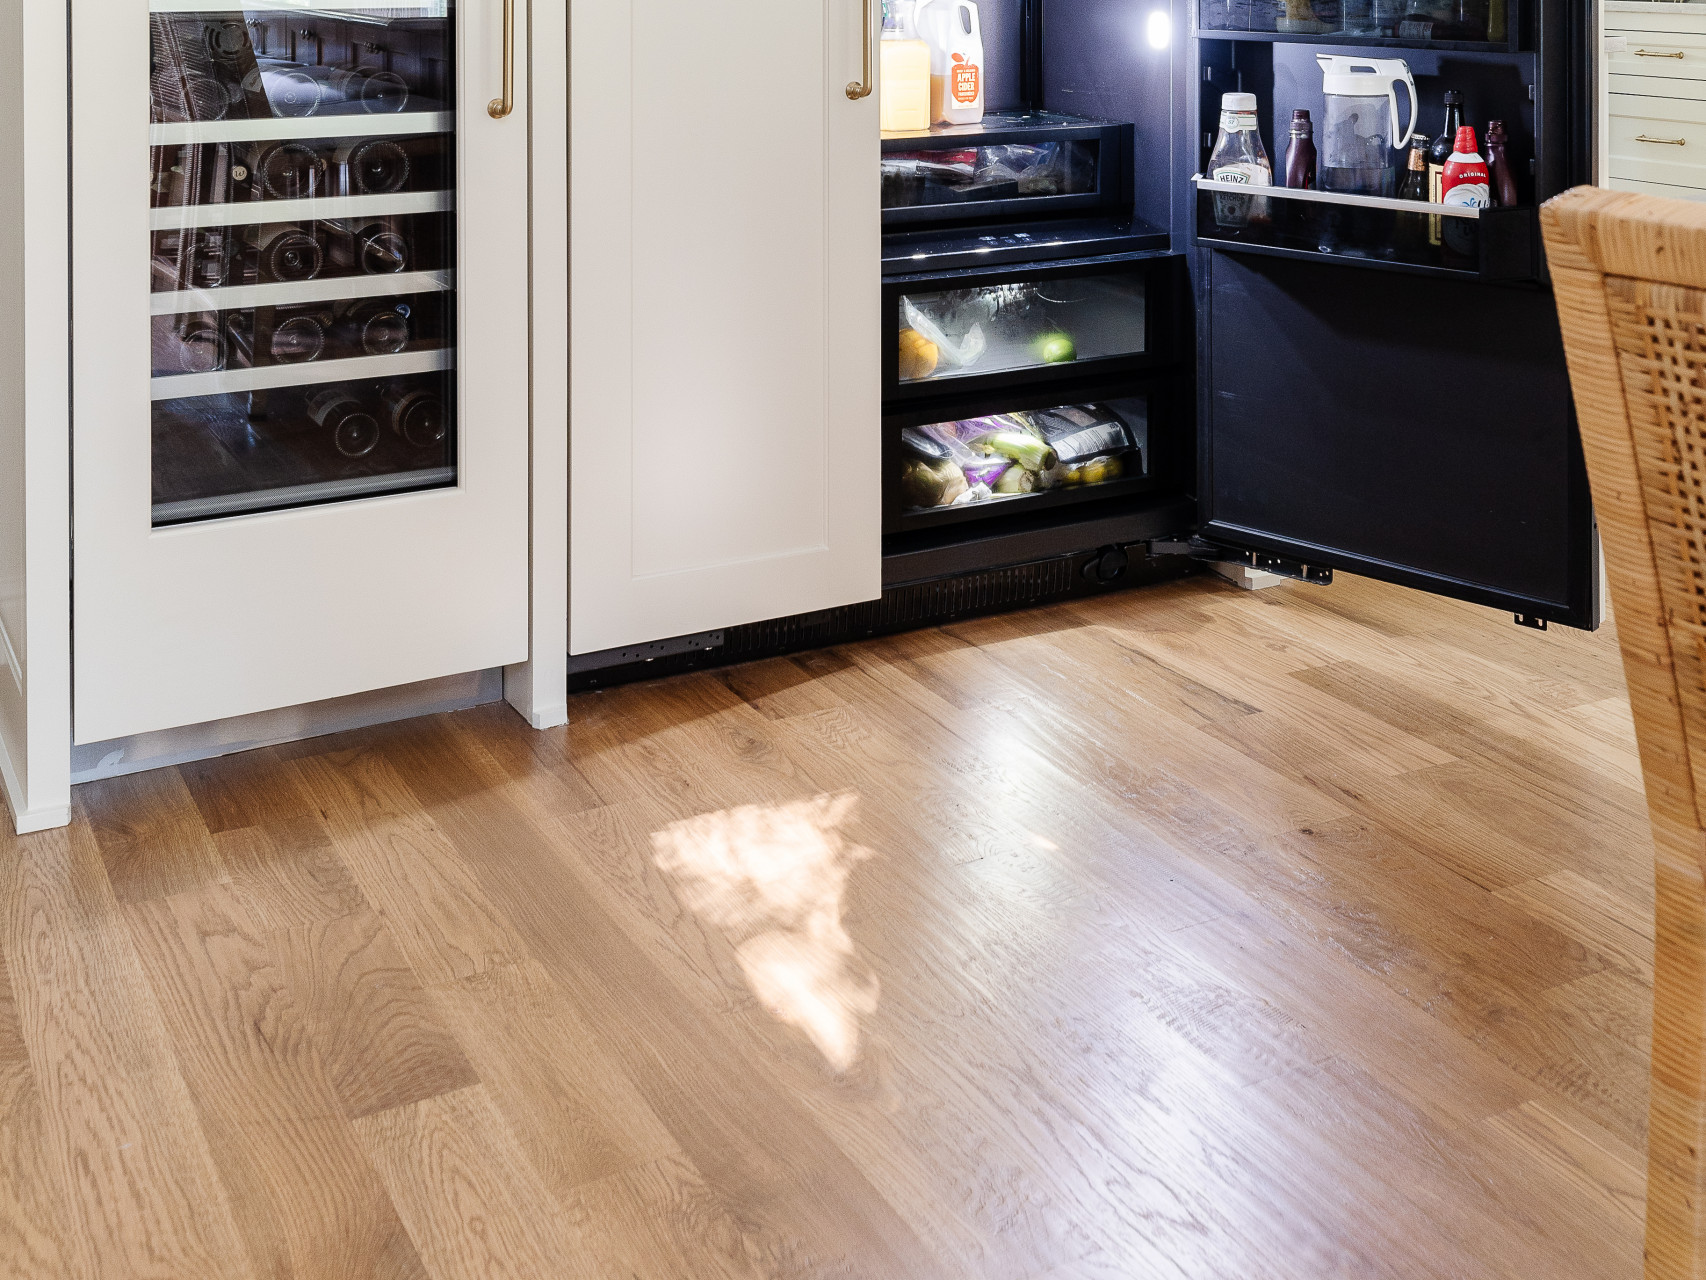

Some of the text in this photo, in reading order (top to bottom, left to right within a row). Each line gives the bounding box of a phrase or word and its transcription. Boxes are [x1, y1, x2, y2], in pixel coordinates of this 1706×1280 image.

[957, 73, 976, 81] APPLE
[958, 82, 975, 91] CIDER
[1220, 174, 1244, 184] HEINZ
